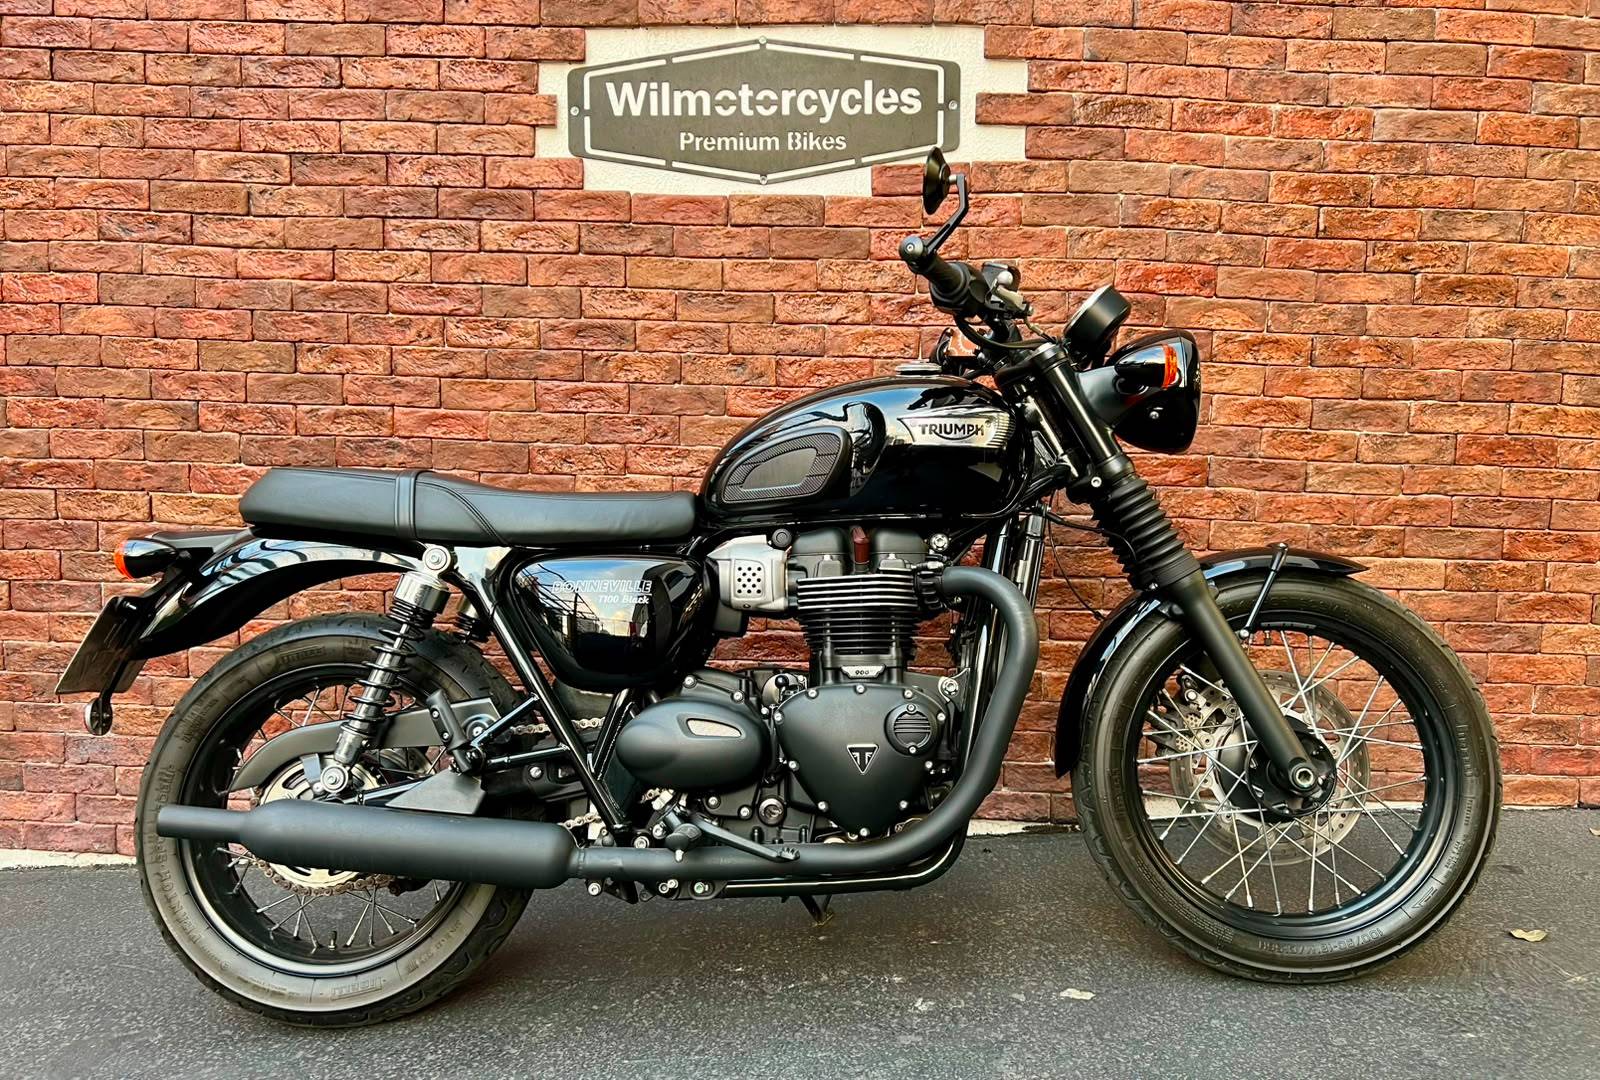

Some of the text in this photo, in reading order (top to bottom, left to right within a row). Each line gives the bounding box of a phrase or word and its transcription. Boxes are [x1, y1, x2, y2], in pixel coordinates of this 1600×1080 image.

[605, 79, 922, 125] Wilmotorcycles
[680, 131, 847, 151] Premium Bikes
[919, 422, 985, 440] TRIUMPH
[551, 580, 653, 595] BONNEVILLE
[622, 595, 650, 604] Black
